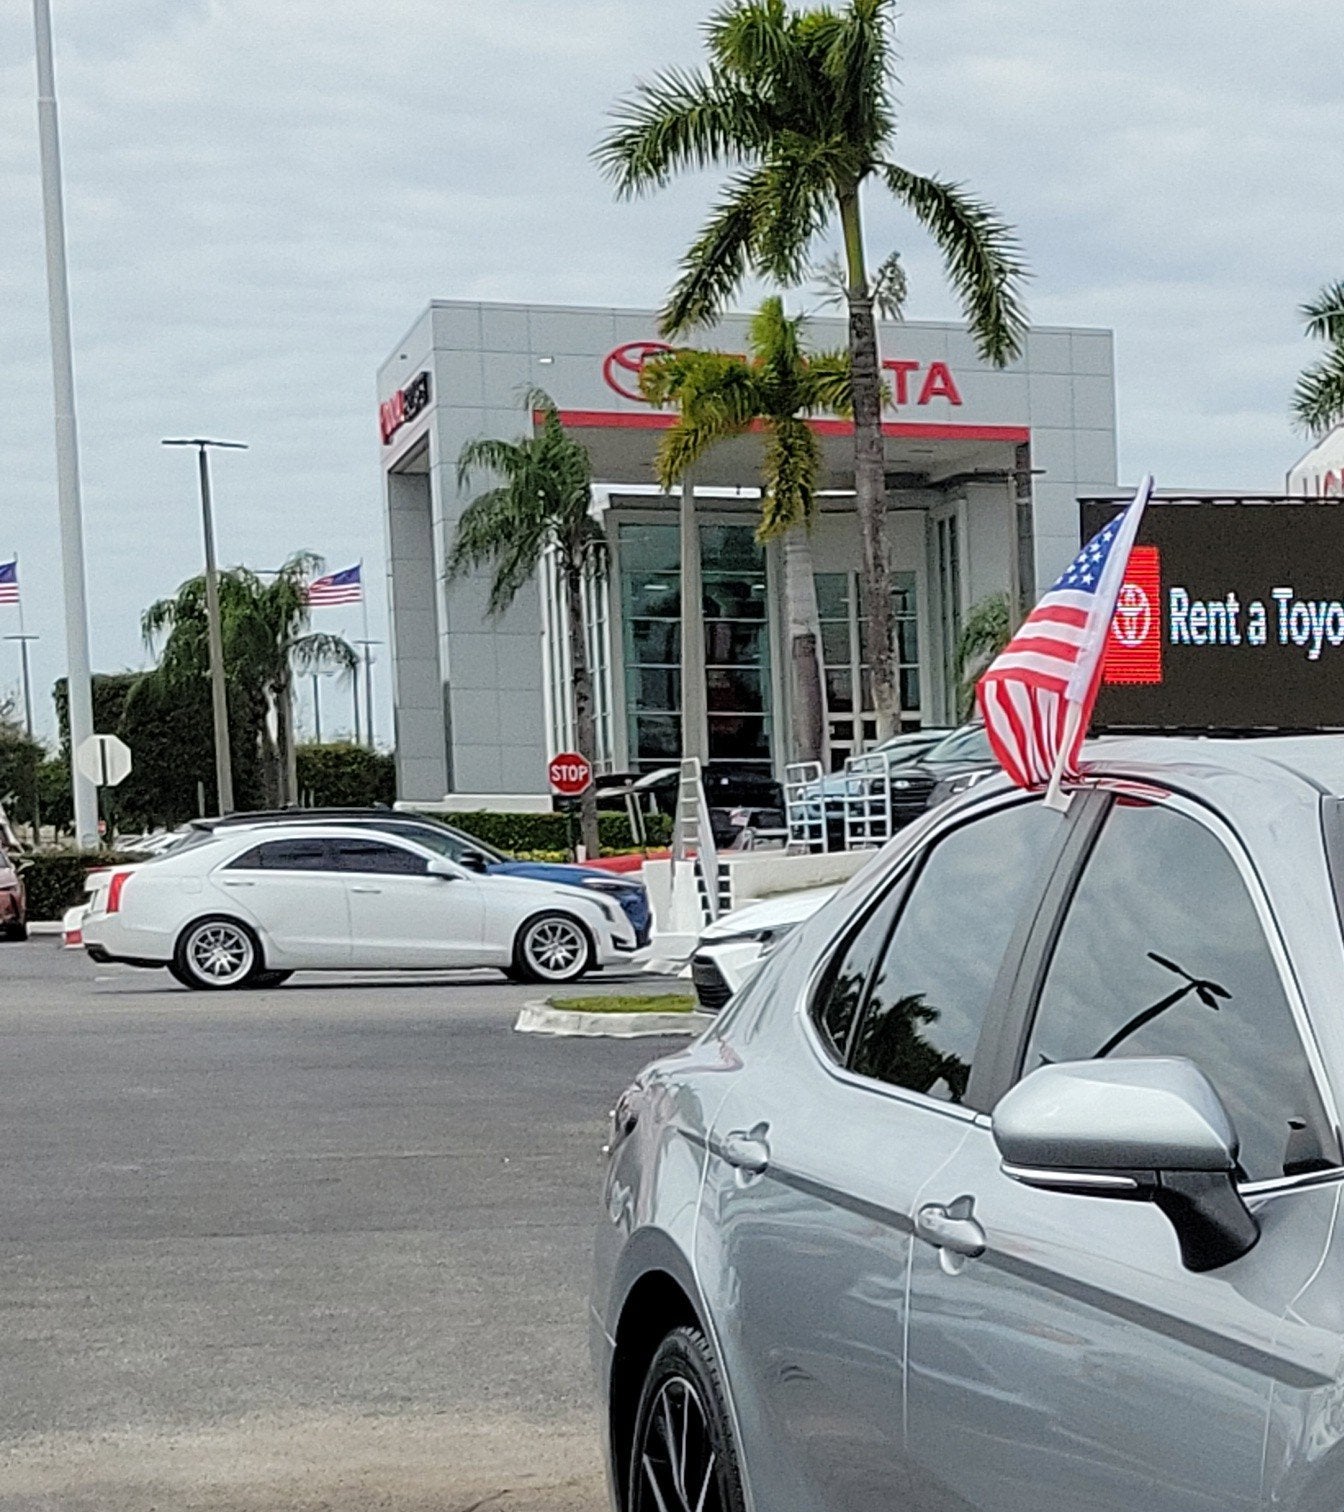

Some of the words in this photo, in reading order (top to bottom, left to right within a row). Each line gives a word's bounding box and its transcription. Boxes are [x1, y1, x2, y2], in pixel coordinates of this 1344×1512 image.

[1168, 586, 1242, 646] Rent
[1247, 600, 1267, 646] a
[551, 764, 588, 782] STOP
